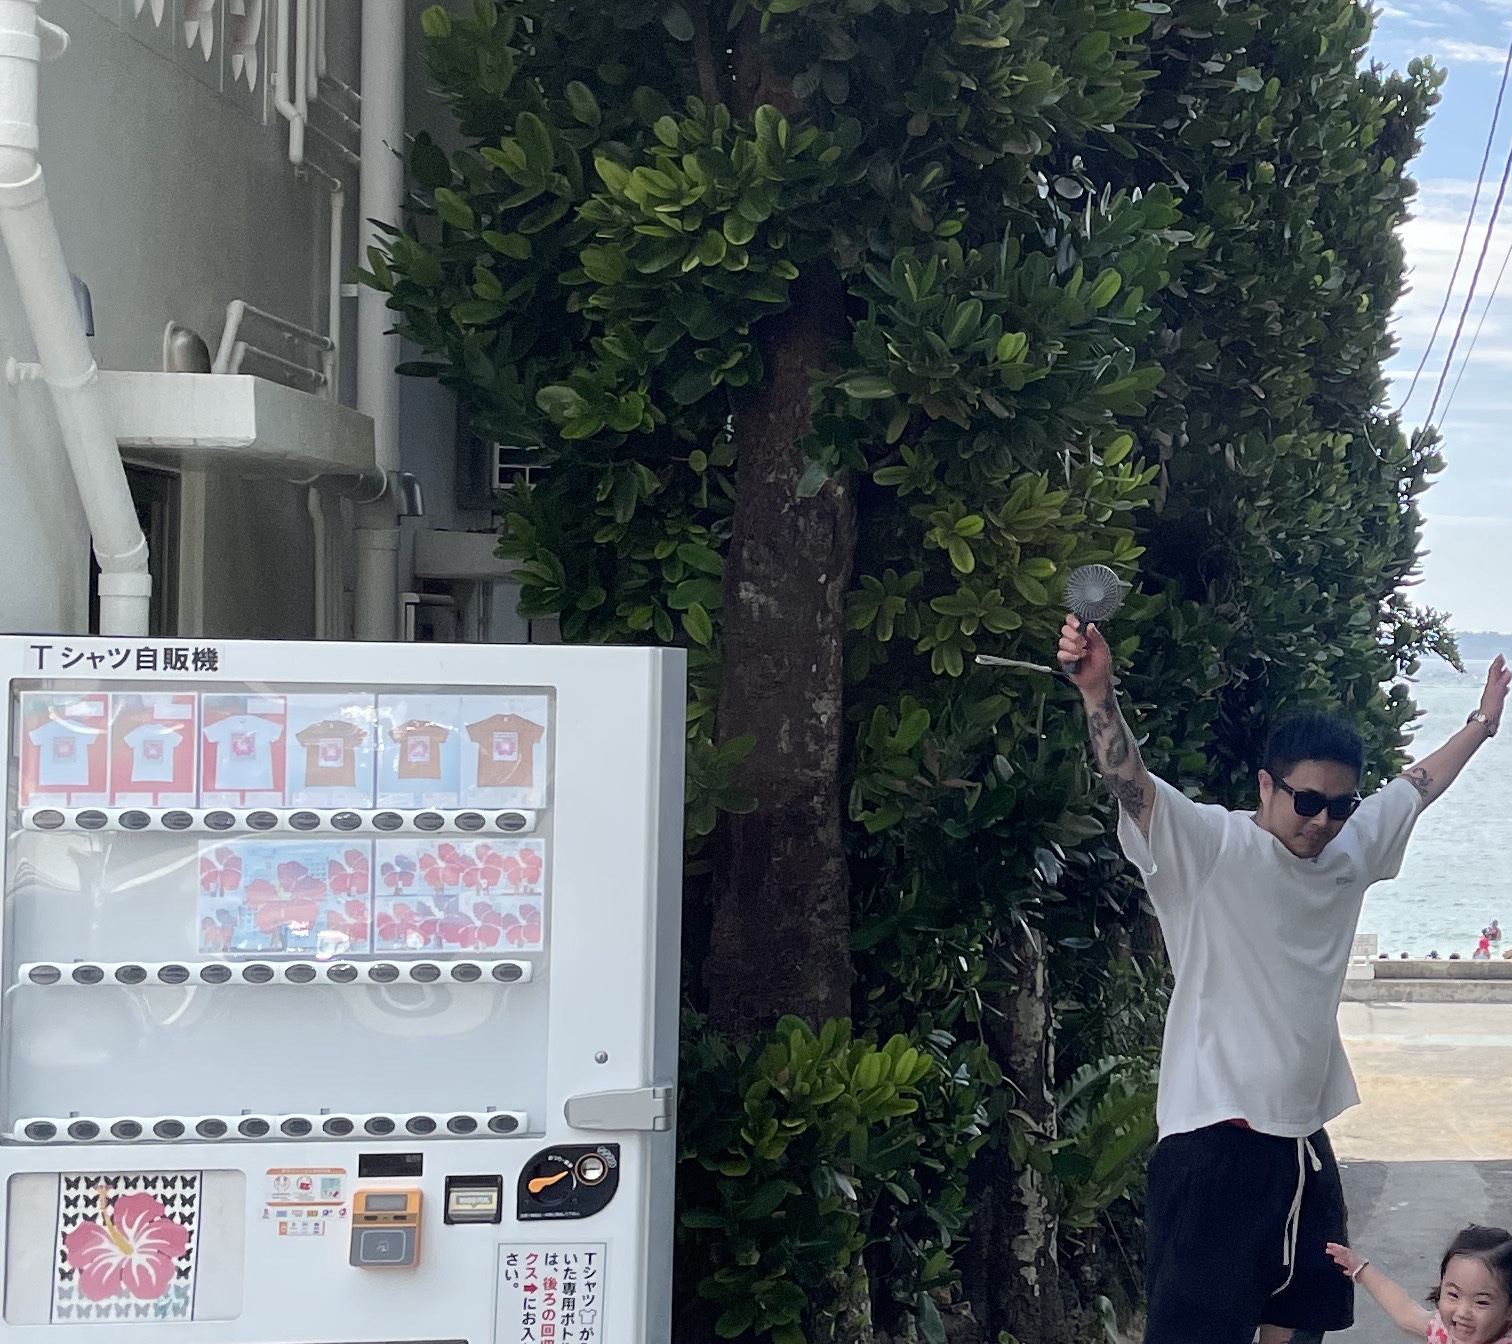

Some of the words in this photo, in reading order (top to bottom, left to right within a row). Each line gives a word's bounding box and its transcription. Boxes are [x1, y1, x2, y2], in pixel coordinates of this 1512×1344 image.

[30, 645, 219, 672] Tシャツ自販機
